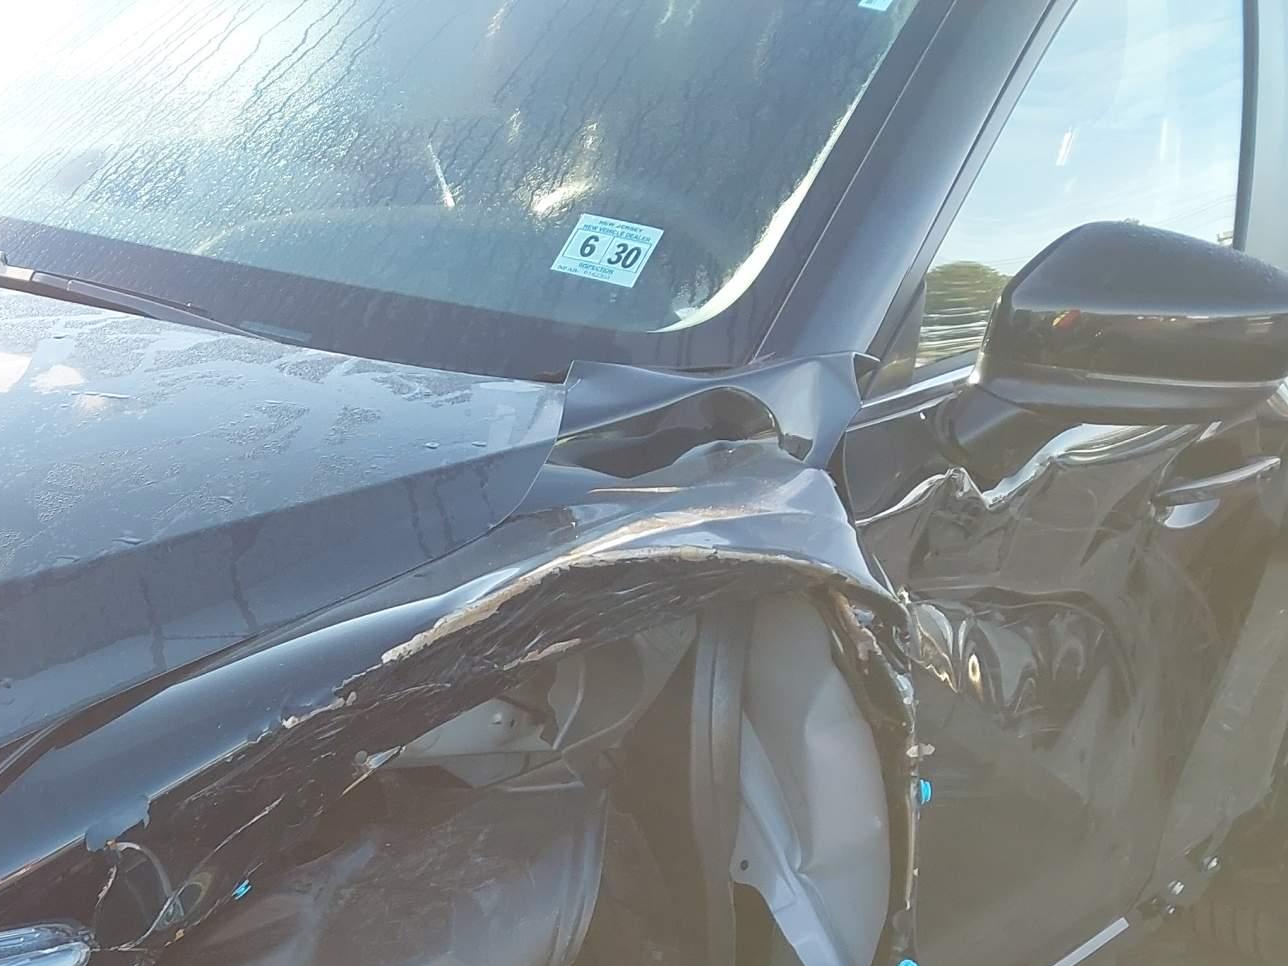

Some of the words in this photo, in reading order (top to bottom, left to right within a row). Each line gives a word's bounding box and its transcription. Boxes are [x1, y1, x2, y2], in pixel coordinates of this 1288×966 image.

[615, 224, 643, 233] JERSEY
[580, 235, 599, 257] 6
[607, 243, 642, 269] 30
